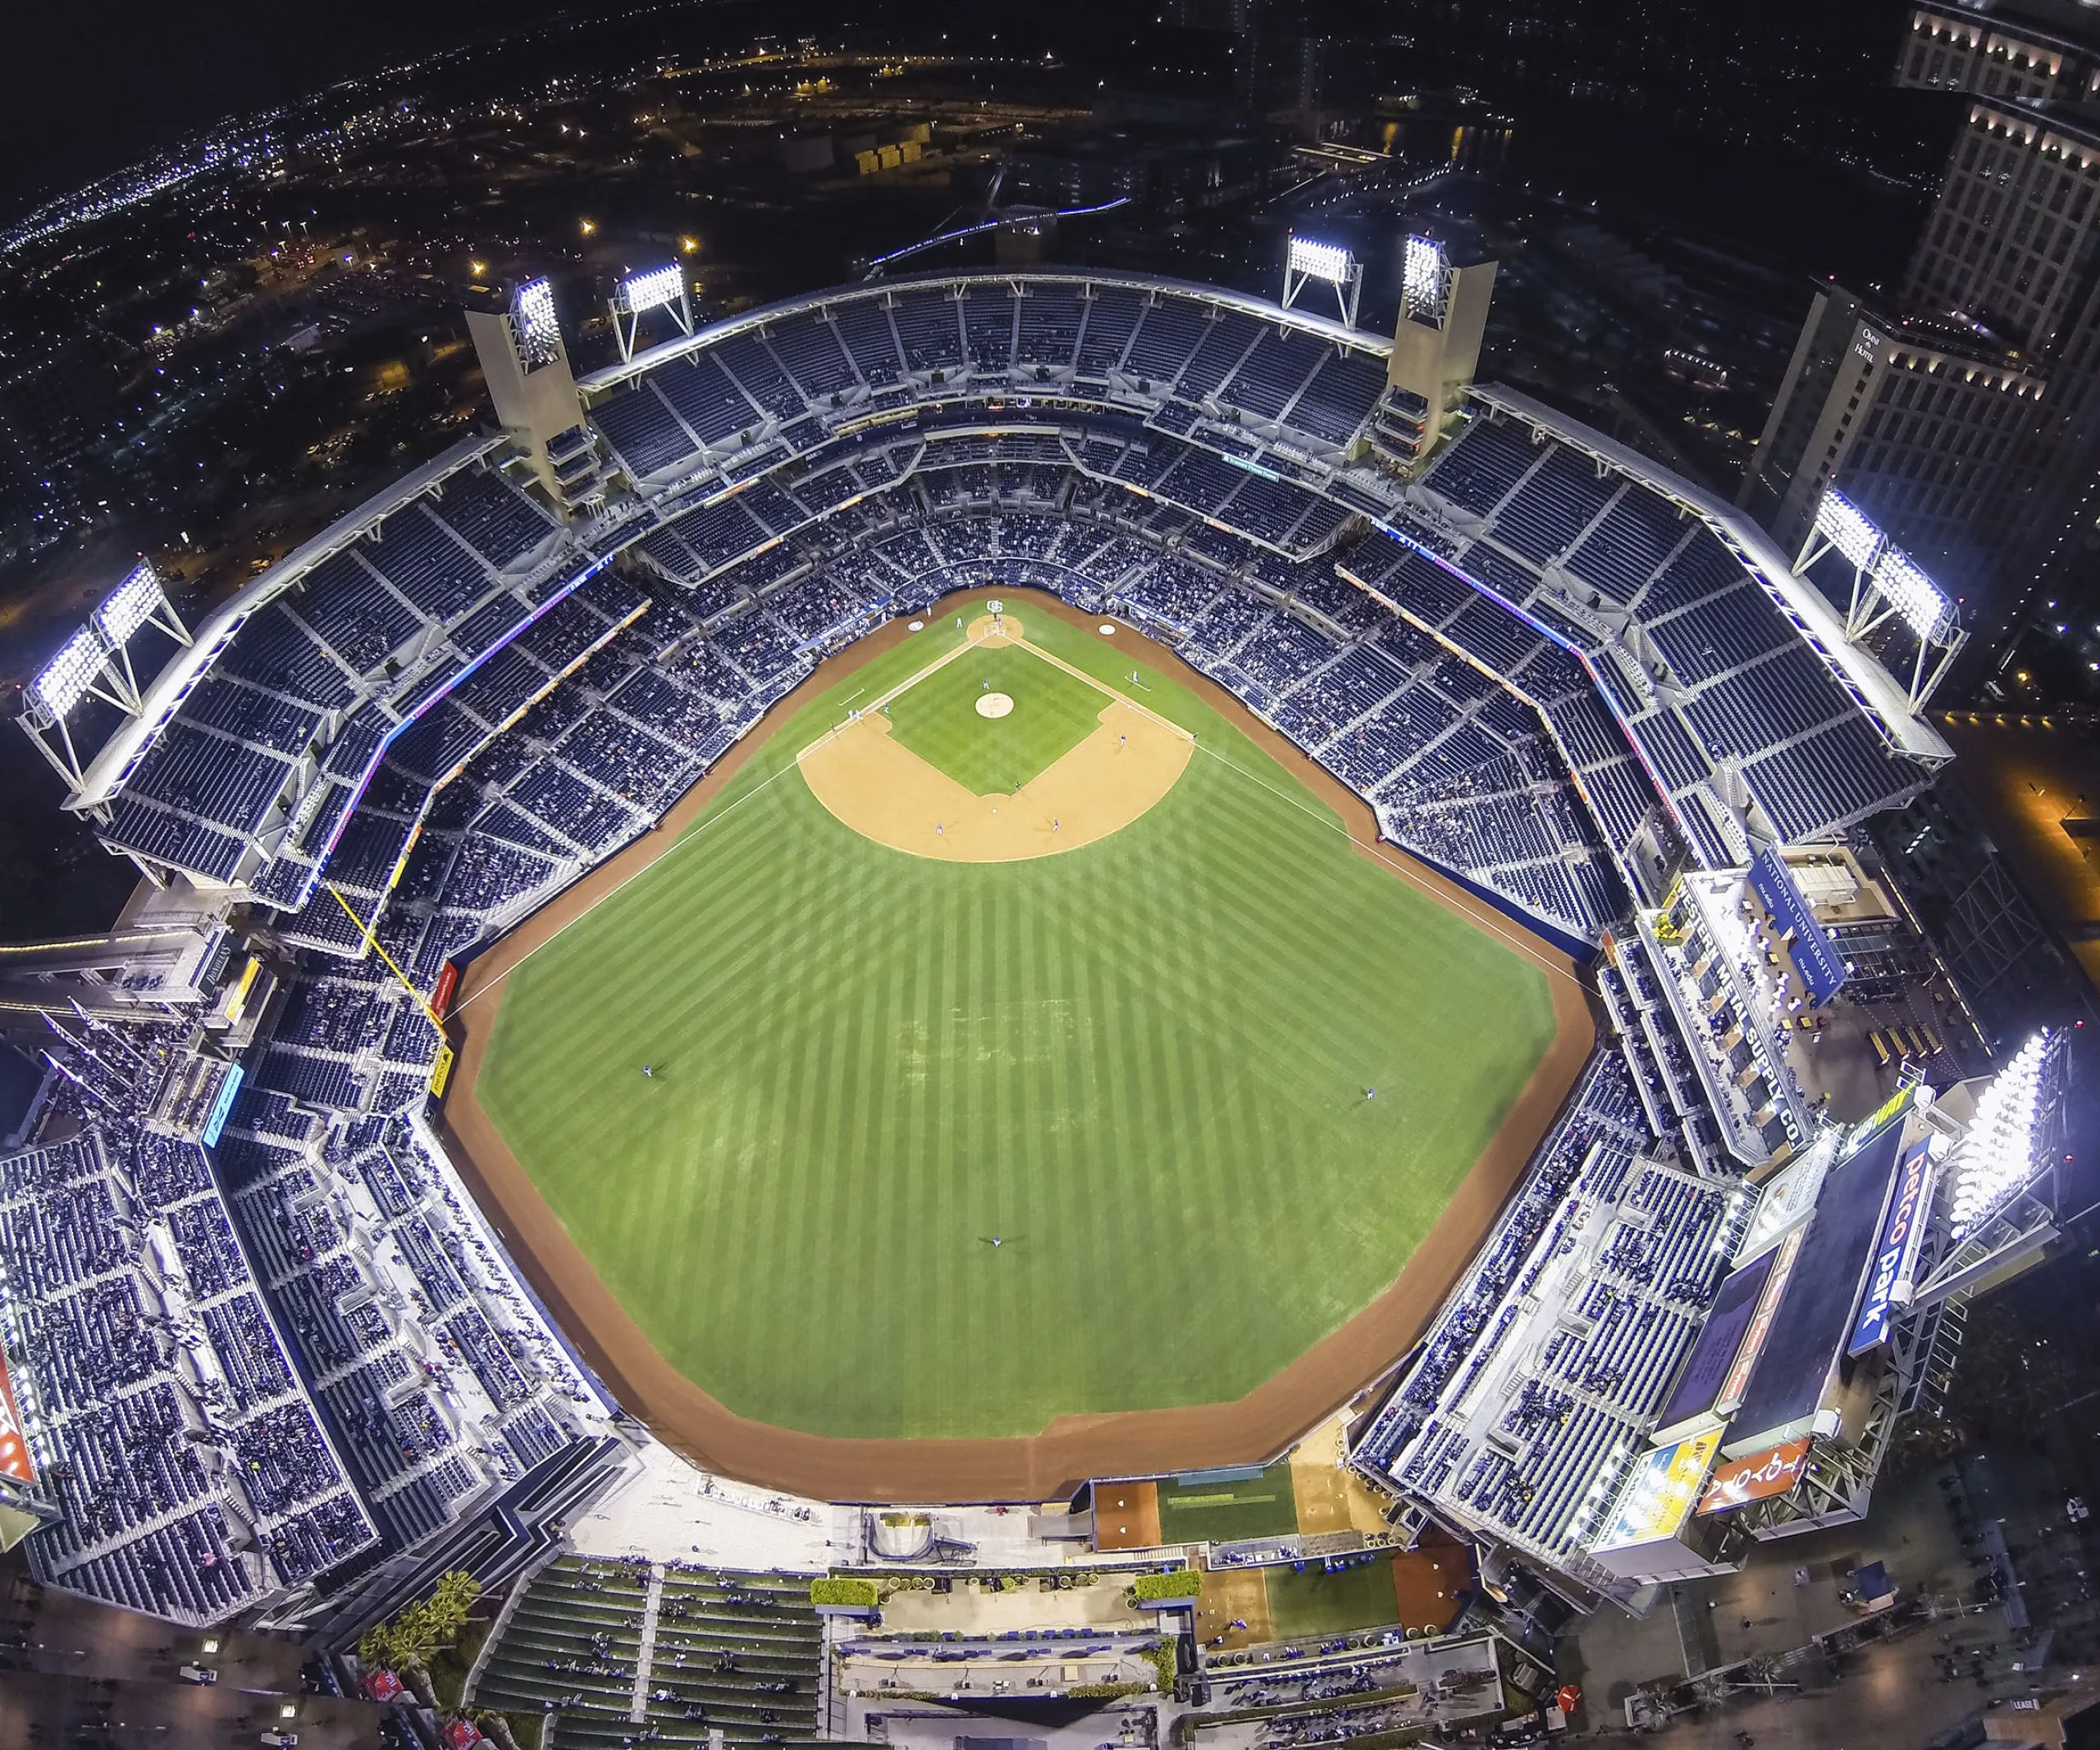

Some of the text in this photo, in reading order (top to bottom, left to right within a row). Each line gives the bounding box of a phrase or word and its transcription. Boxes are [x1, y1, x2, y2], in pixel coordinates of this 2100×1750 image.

[1758, 882, 1775, 909] nu.edu
[1761, 852, 1838, 986] NATIONAL UNIVERSITY
[1676, 878, 1721, 962] WESTERN
[1716, 962, 1751, 1028] METAL
[1746, 1027, 1785, 1102] SUPPLY
[1779, 1107, 1800, 1147] CO.
[1797, 957, 1815, 986] nu.edu
[1861, 1151, 1926, 1330] petco park
